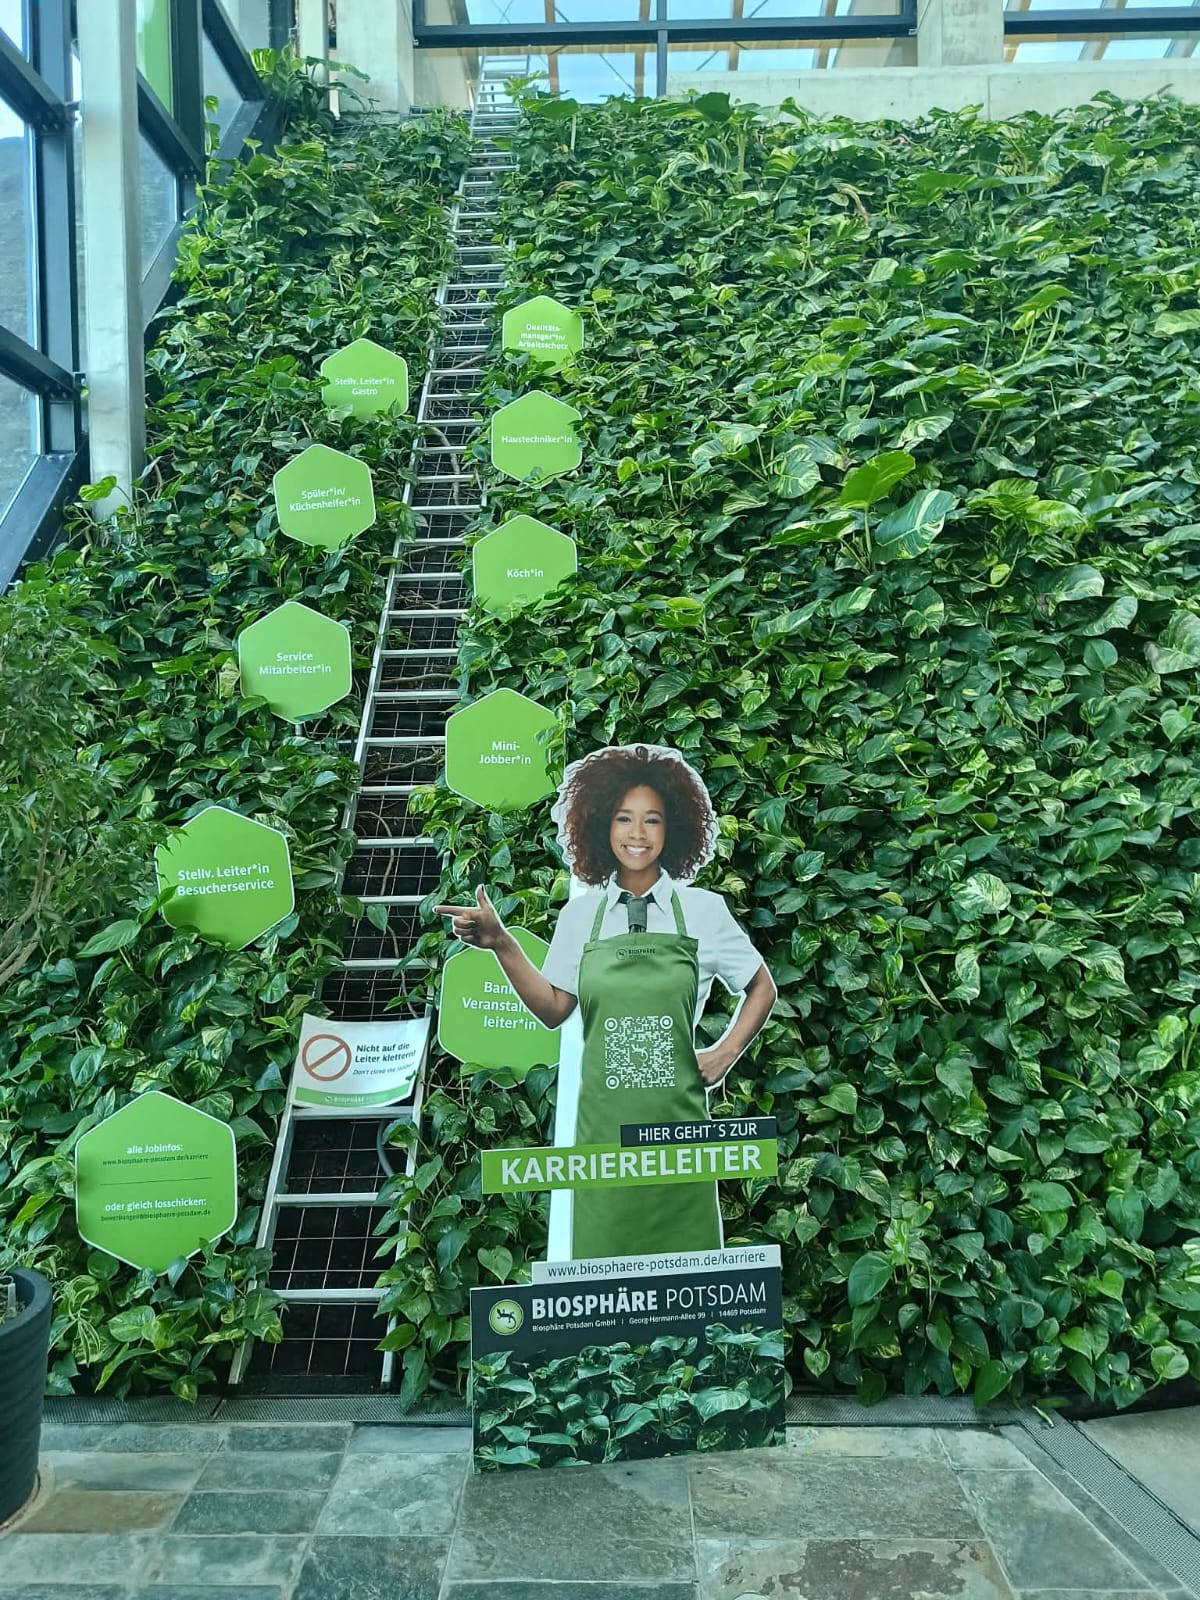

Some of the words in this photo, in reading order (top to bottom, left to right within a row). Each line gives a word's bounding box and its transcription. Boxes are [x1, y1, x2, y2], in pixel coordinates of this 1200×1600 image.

[276, 652, 313, 662] Service
[492, 741, 520, 751] Mini-
[178, 868, 214, 881] Stellv.
[178, 879, 274, 896] Besucherservice
[356, 1044, 380, 1052] Nicht
[382, 1044, 396, 1052] auf
[398, 1042, 410, 1050] die
[355, 1054, 380, 1062] Leiter
[382, 1050, 416, 1062] klettern!
[639, 1127, 671, 1142] HIER
[730, 1122, 758, 1136] ZUR
[127, 1145, 142, 1154] alle
[144, 1144, 184, 1154] Jobinfos:
[502, 1144, 762, 1185] KARRIERELEITER
[106, 1202, 126, 1212] oder
[127, 1200, 153, 1212] gleich
[154, 1198, 206, 1208] losschicken:
[548, 1251, 766, 1277] www.biosphaere-potsdam.de/karriere
[532, 1287, 658, 1320] BIOSPHÄRE
[666, 1281, 766, 1310] POTSDAM
[532, 1323, 564, 1332] Biosphäre
[566, 1321, 594, 1330] Potsdam
[594, 1318, 616, 1326] GmbH
[629, 1312, 696, 1324] Georg-Hermann-Allee
